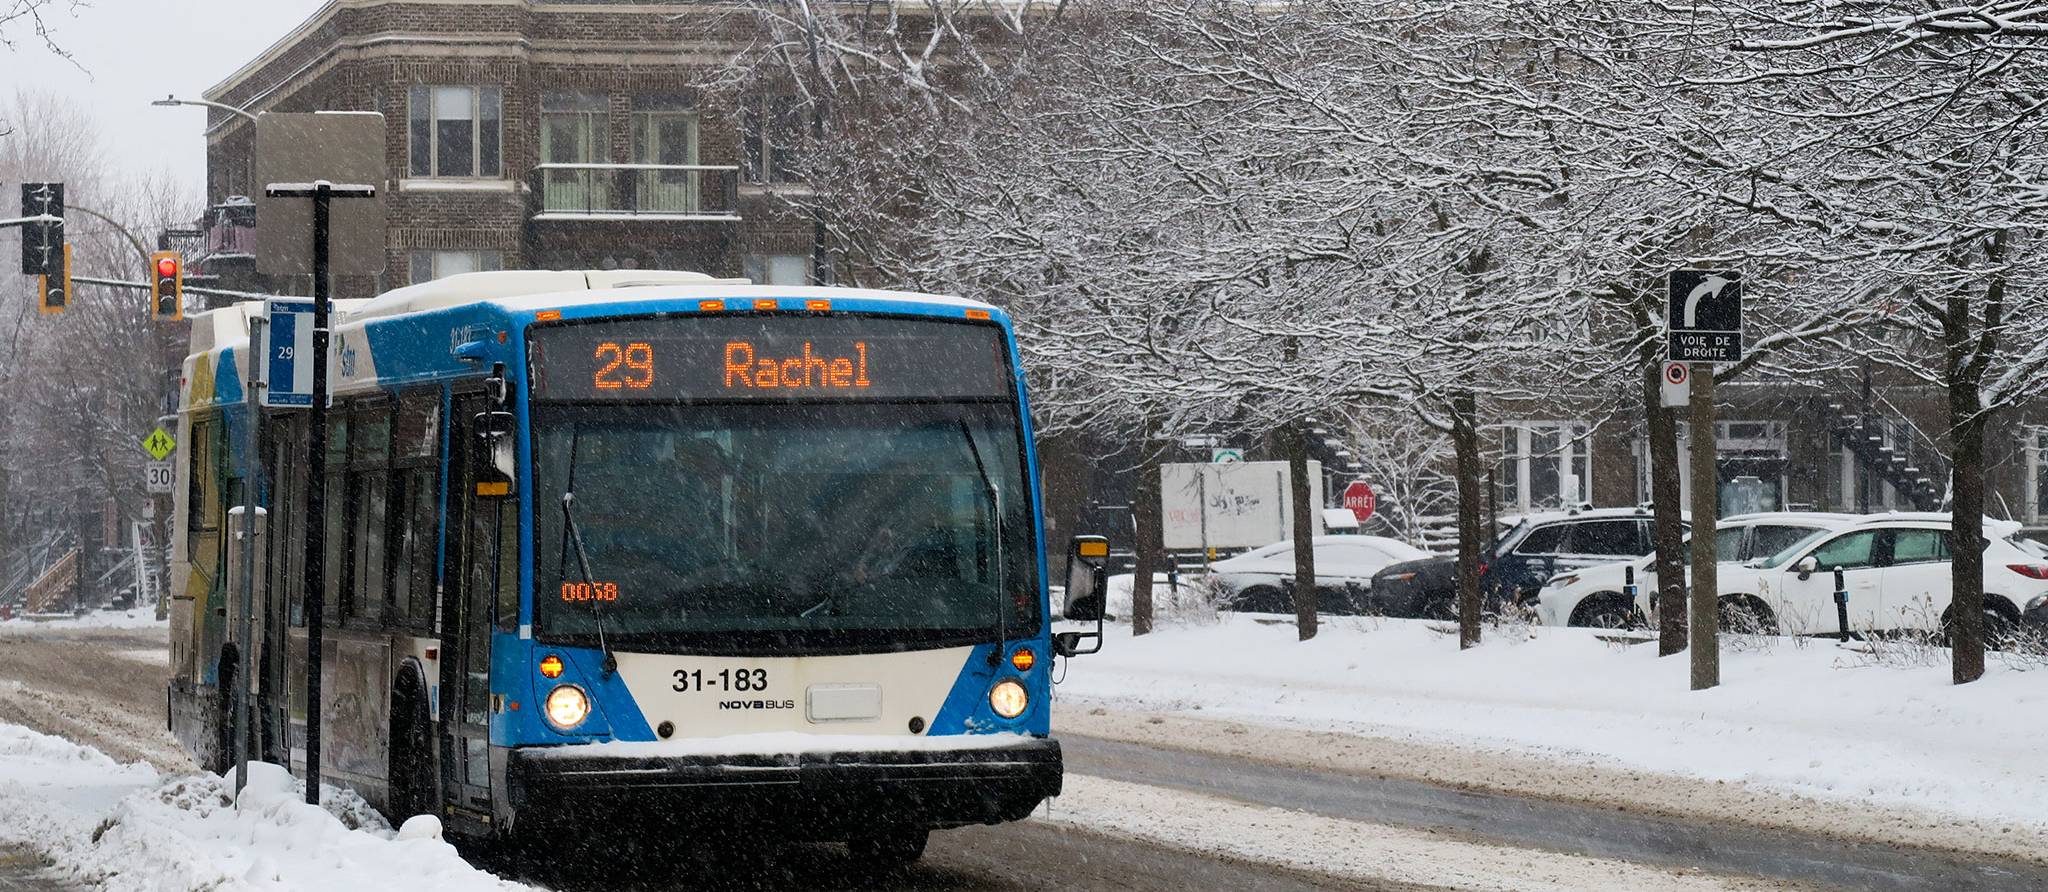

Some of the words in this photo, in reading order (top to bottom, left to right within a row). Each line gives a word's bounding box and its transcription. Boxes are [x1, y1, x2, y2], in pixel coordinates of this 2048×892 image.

[1680, 336, 1707, 346] VOIE
[1715, 336, 1731, 346] DE
[278, 346, 294, 360] 29
[1684, 347, 1727, 358] DROITE
[594, 342, 654, 389] 29
[724, 341, 871, 388] Rachel
[149, 468, 170, 485] 30
[1345, 494, 1374, 508] ARRÊT
[672, 668, 768, 692] 31-183
